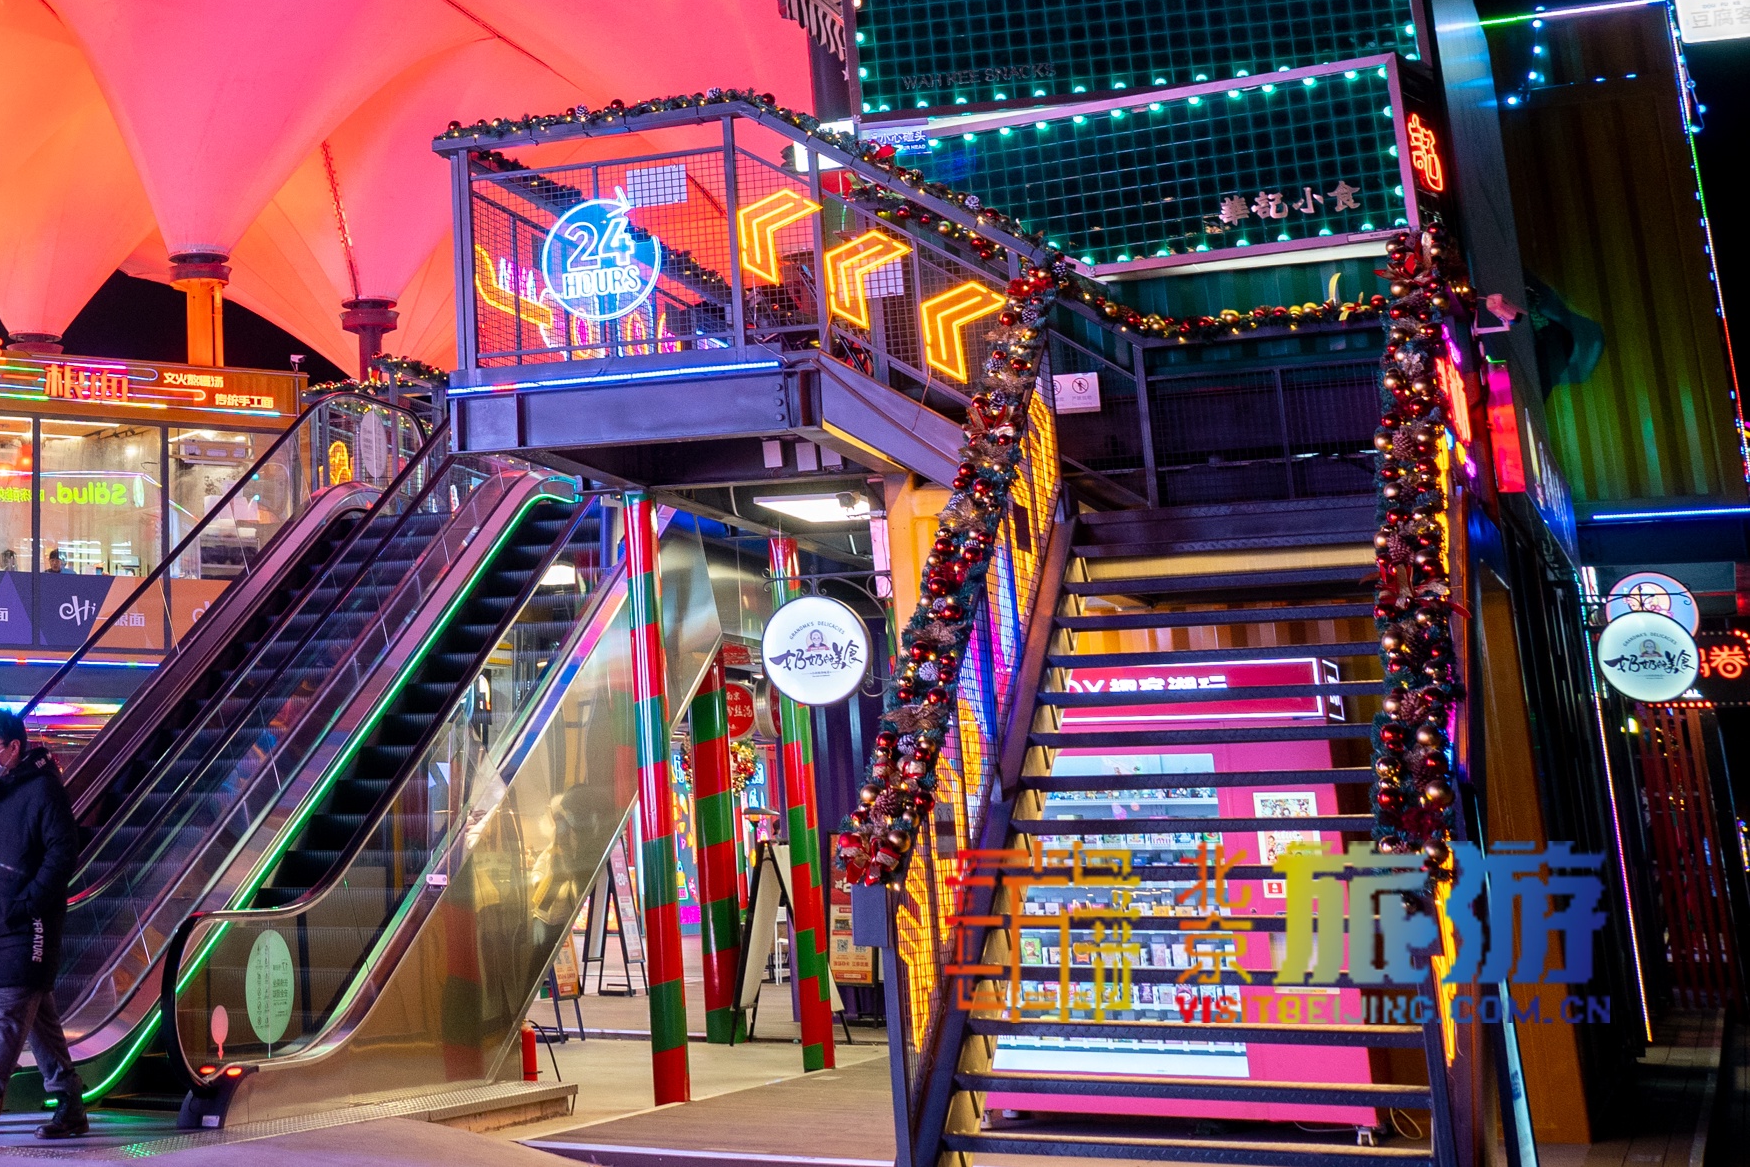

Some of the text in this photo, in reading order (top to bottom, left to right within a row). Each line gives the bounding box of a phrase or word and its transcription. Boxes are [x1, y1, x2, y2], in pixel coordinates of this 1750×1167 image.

[901, 62, 1057, 90] WAH KEE SNACKS
[1219, 180, 1360, 226] 華記小食
[564, 217, 635, 271] 24
[562, 265, 641, 299] HOURS
[817, 621, 845, 635] DELICACIES
